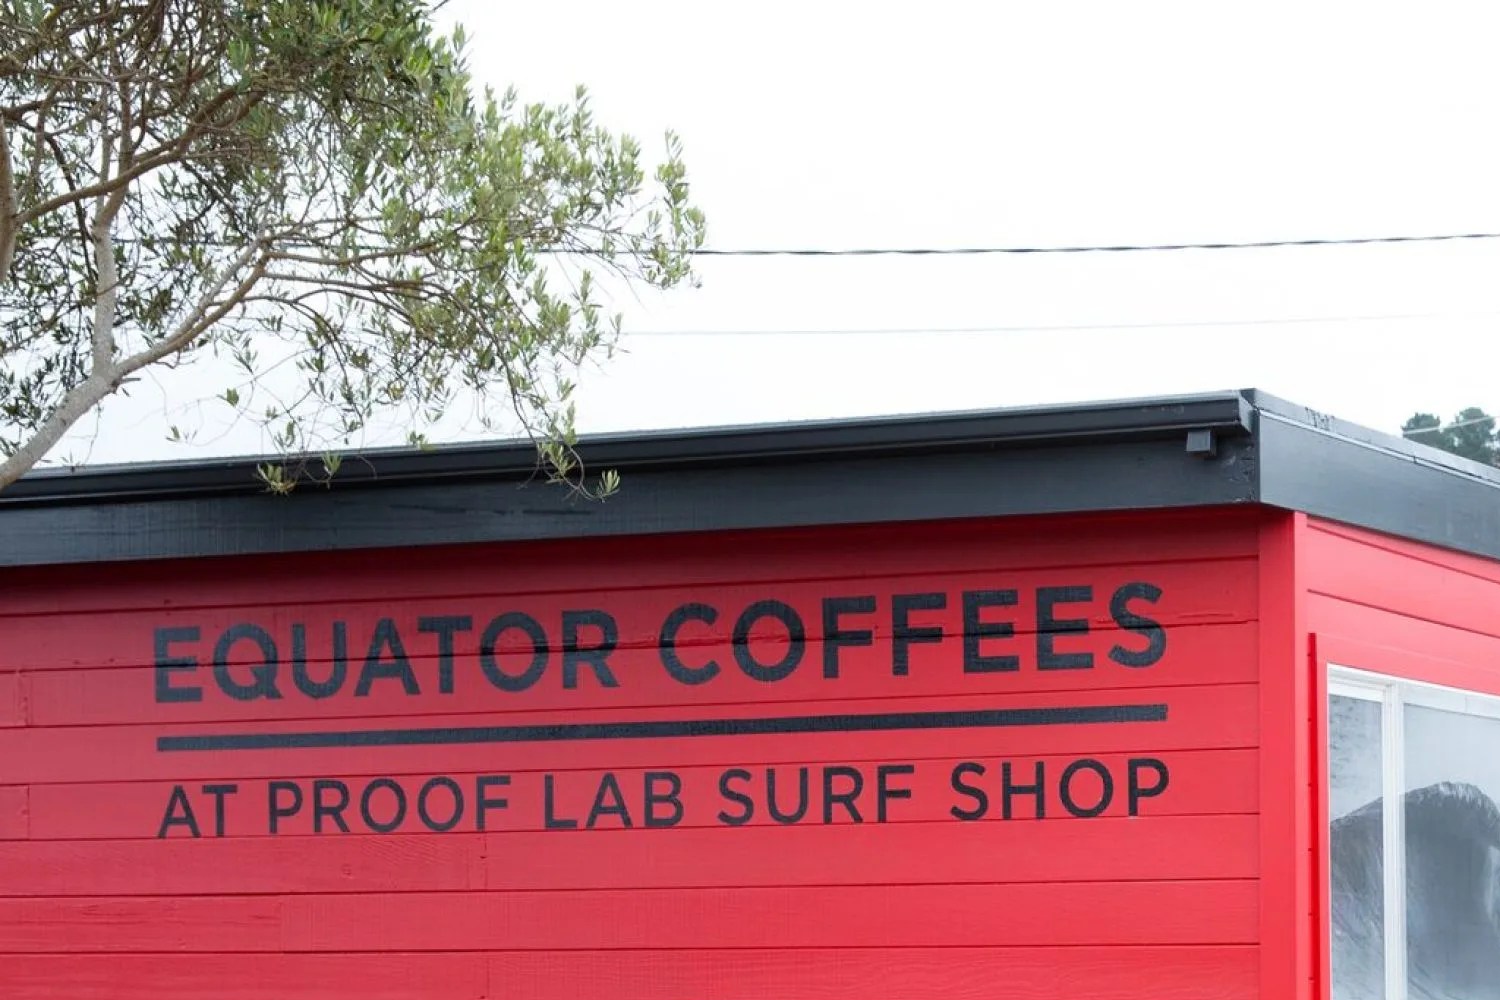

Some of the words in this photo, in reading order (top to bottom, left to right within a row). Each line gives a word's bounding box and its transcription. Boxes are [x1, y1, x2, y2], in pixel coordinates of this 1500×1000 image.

[153, 608, 621, 703] EQUATOR
[658, 582, 1168, 686] COFFEES
[157, 784, 238, 839] AT
[267, 774, 512, 835] PROOF
[543, 771, 685, 830] LAB
[717, 764, 915, 826] SURF
[950, 757, 1170, 822] SHOP
